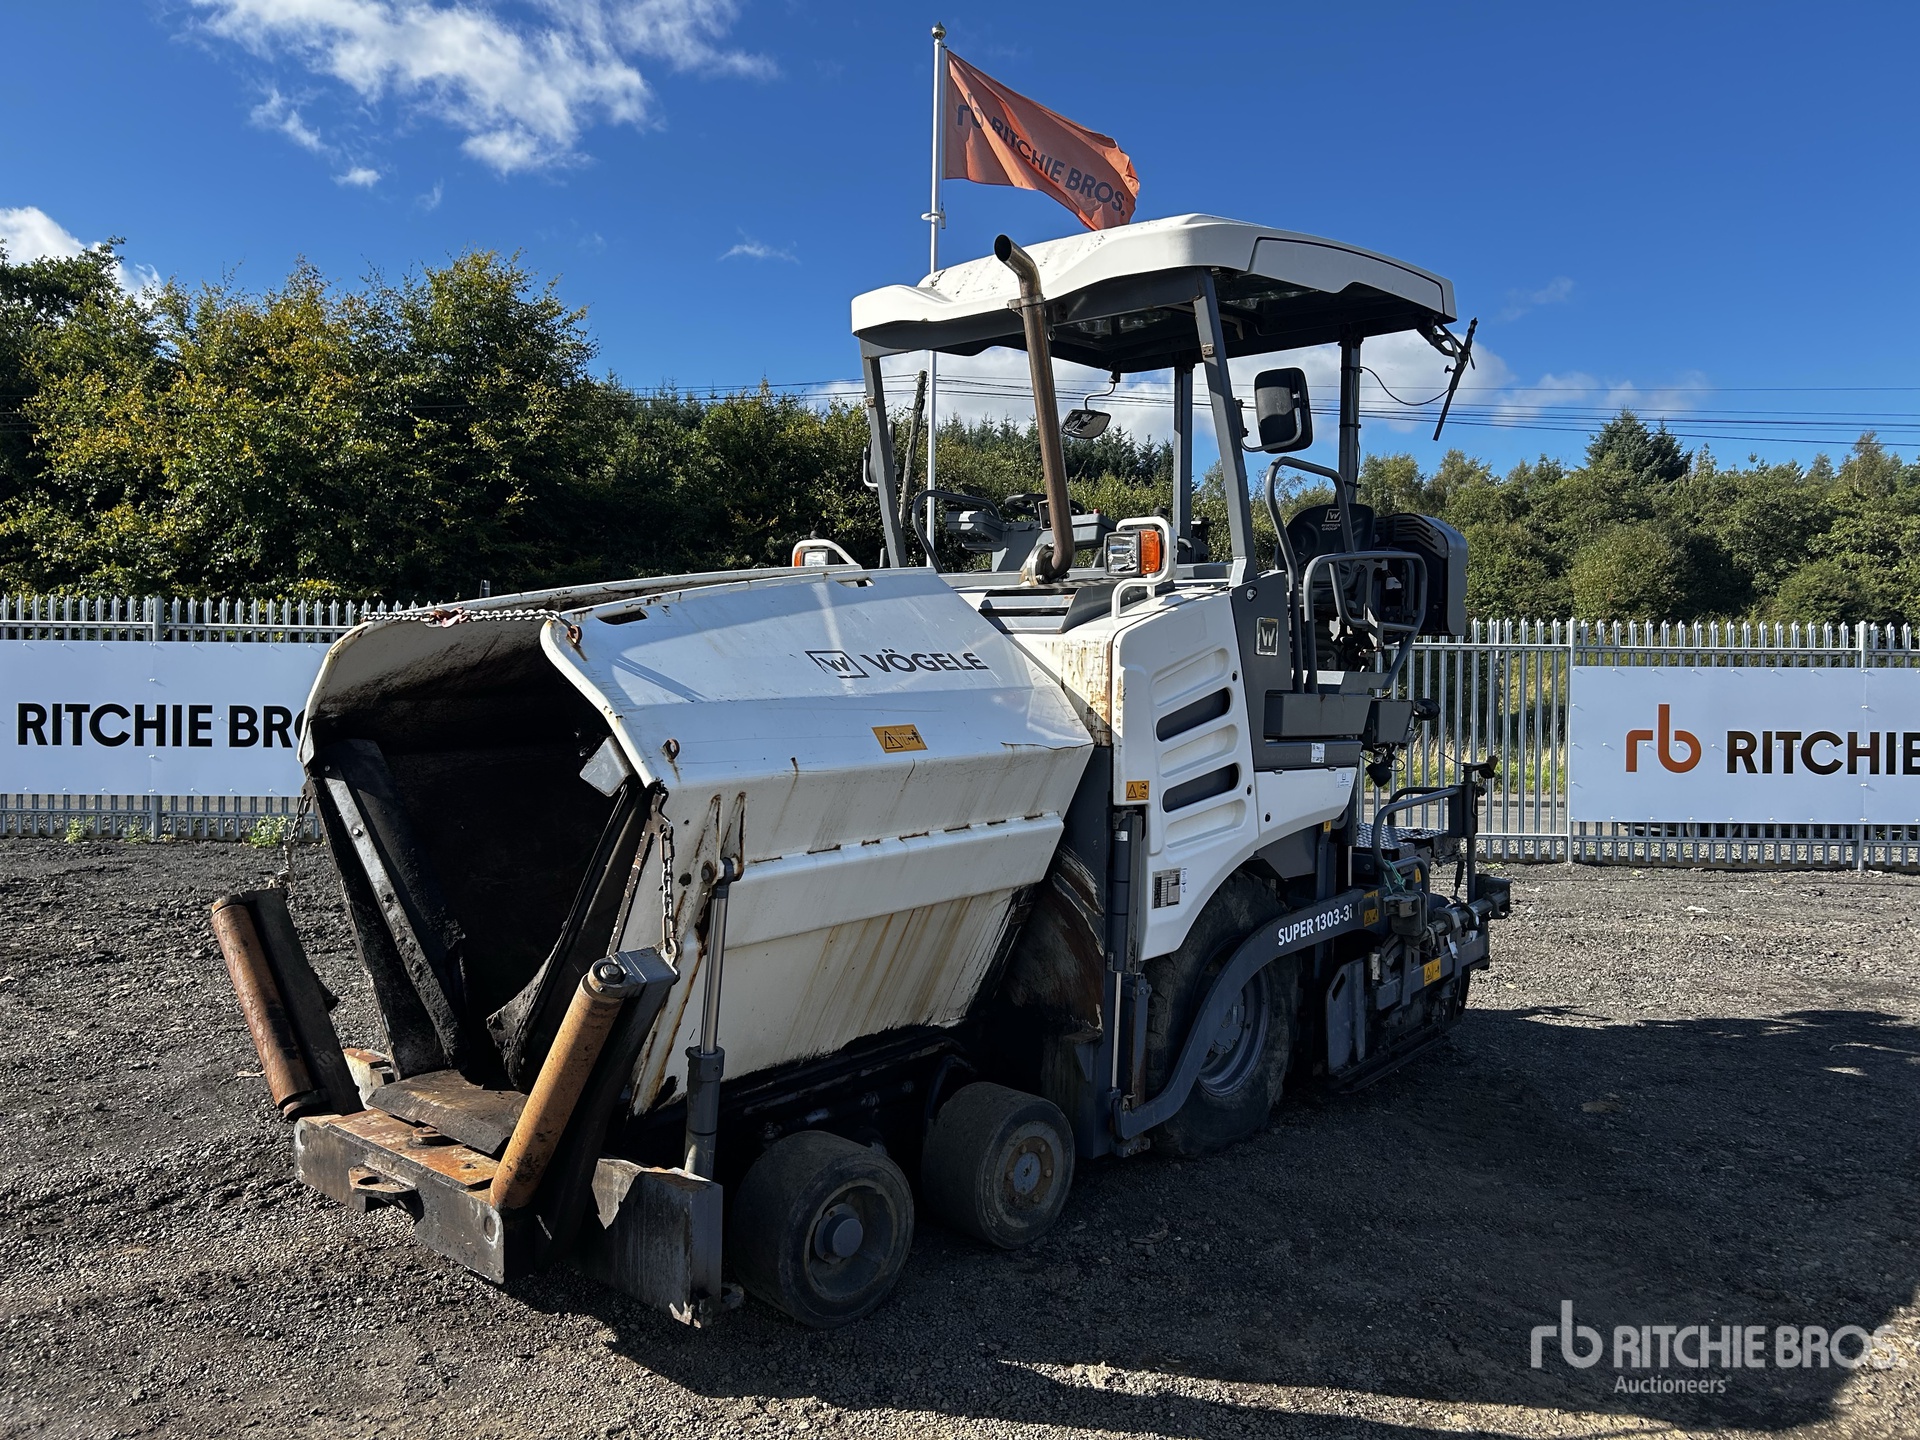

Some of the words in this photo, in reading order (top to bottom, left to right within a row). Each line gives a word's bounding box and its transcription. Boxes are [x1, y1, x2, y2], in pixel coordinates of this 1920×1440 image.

[991, 116, 1065, 183] RITCHIE
[1065, 167, 1126, 216] BROS.
[859, 648, 990, 673] VÖGELE
[17, 702, 213, 747] RITCHIE
[1625, 703, 1702, 773] rb
[1726, 730, 1920, 775] RITCHIE
[1277, 918, 1314, 946] SUPER
[1314, 903, 1353, 933] 1303-3i
